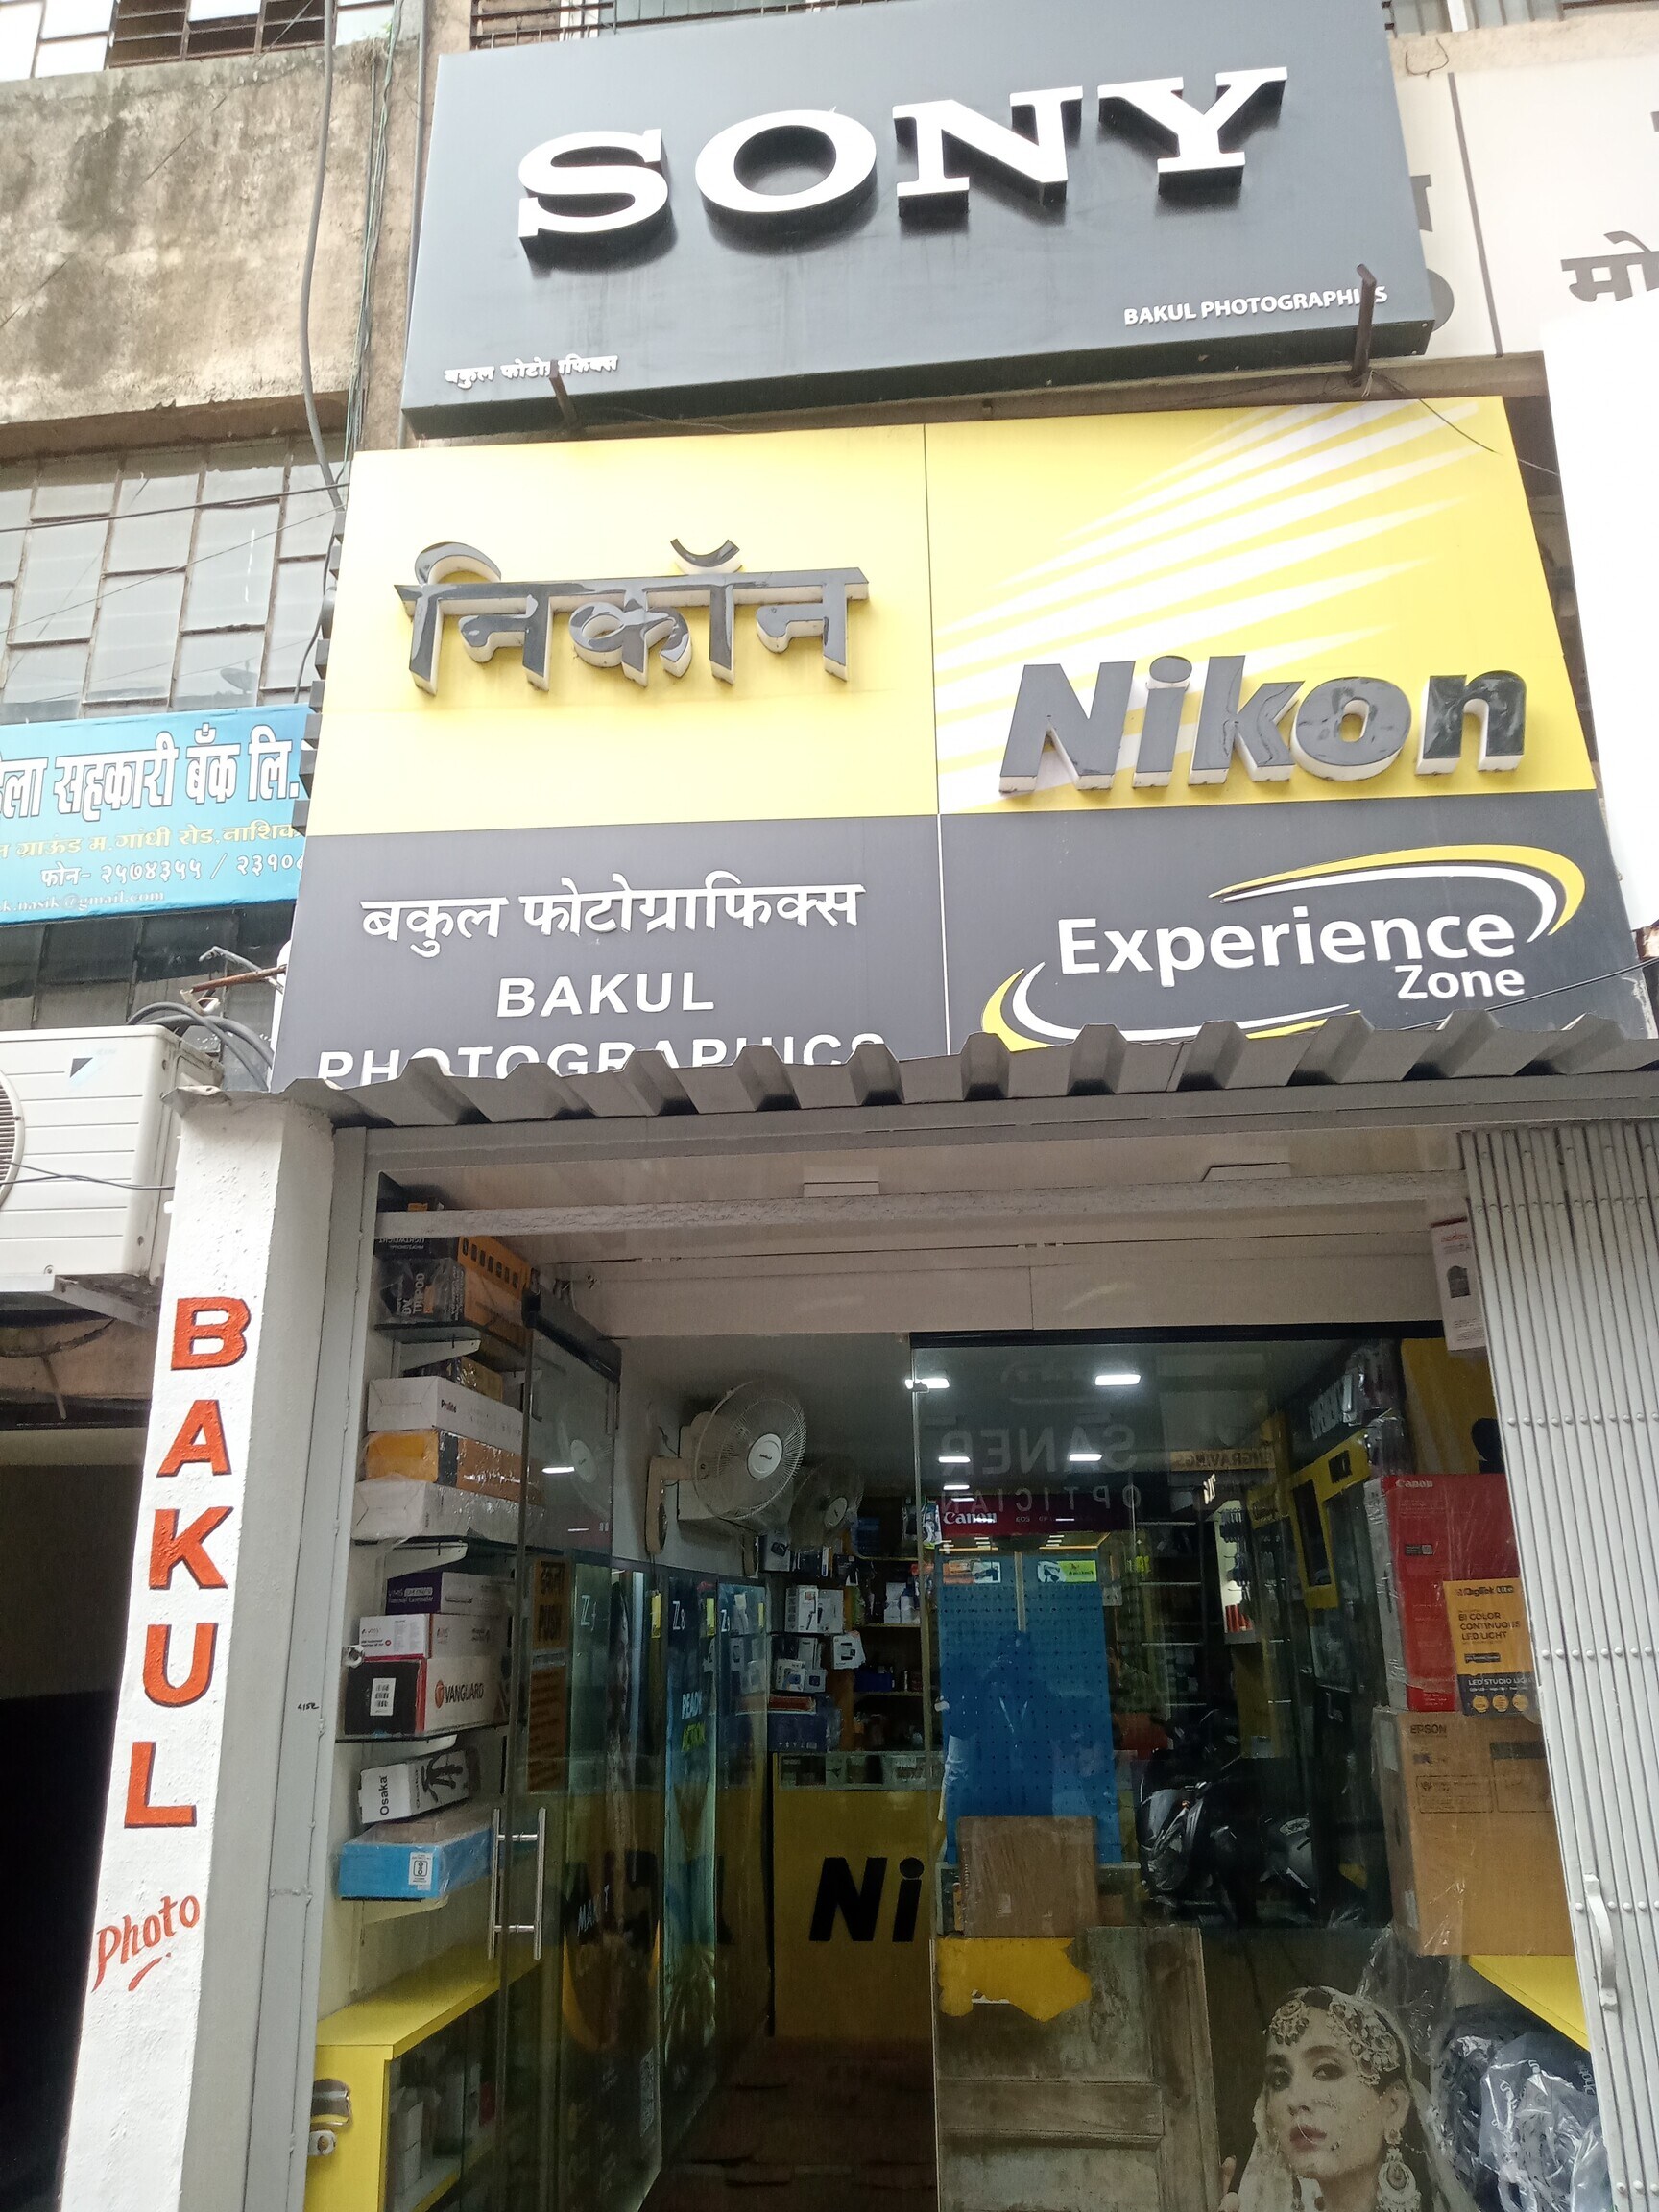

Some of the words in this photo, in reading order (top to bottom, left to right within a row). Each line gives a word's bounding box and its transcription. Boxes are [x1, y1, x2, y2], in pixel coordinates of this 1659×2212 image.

[517, 65, 1288, 246] SONY
[1123, 301, 1197, 326] BAKUL
[1201, 285, 1389, 319] PHOTOGRAPHIS
[393, 540, 871, 697] निकॉन
[998, 654, 1528, 795] Nikon
[53, 730, 180, 823] सहकारी
[360, 896, 509, 959] बकुल
[518, 869, 867, 936] फोटोग्राफिक्स
[1056, 905, 1517, 989] Experience
[495, 971, 716, 1019] BAKUL
[1397, 963, 1526, 1002] Zone
[1395, 1479, 1434, 1489] Canon
[943, 1511, 998, 1525] Canon
[123, 1296, 252, 1830] BAKUL
[1459, 1620, 1521, 1631] CONTINUOUS
[1461, 1632, 1479, 1641] LED
[1469, 1612, 1502, 1621] COLOR
[445, 1682, 485, 1704] VANGUARD
[1484, 1677, 1512, 1686] STUDIO
[1409, 1724, 1447, 1734] EPSON
[378, 1775, 390, 1816] Osaka
[92, 1893, 201, 1993] Photo
